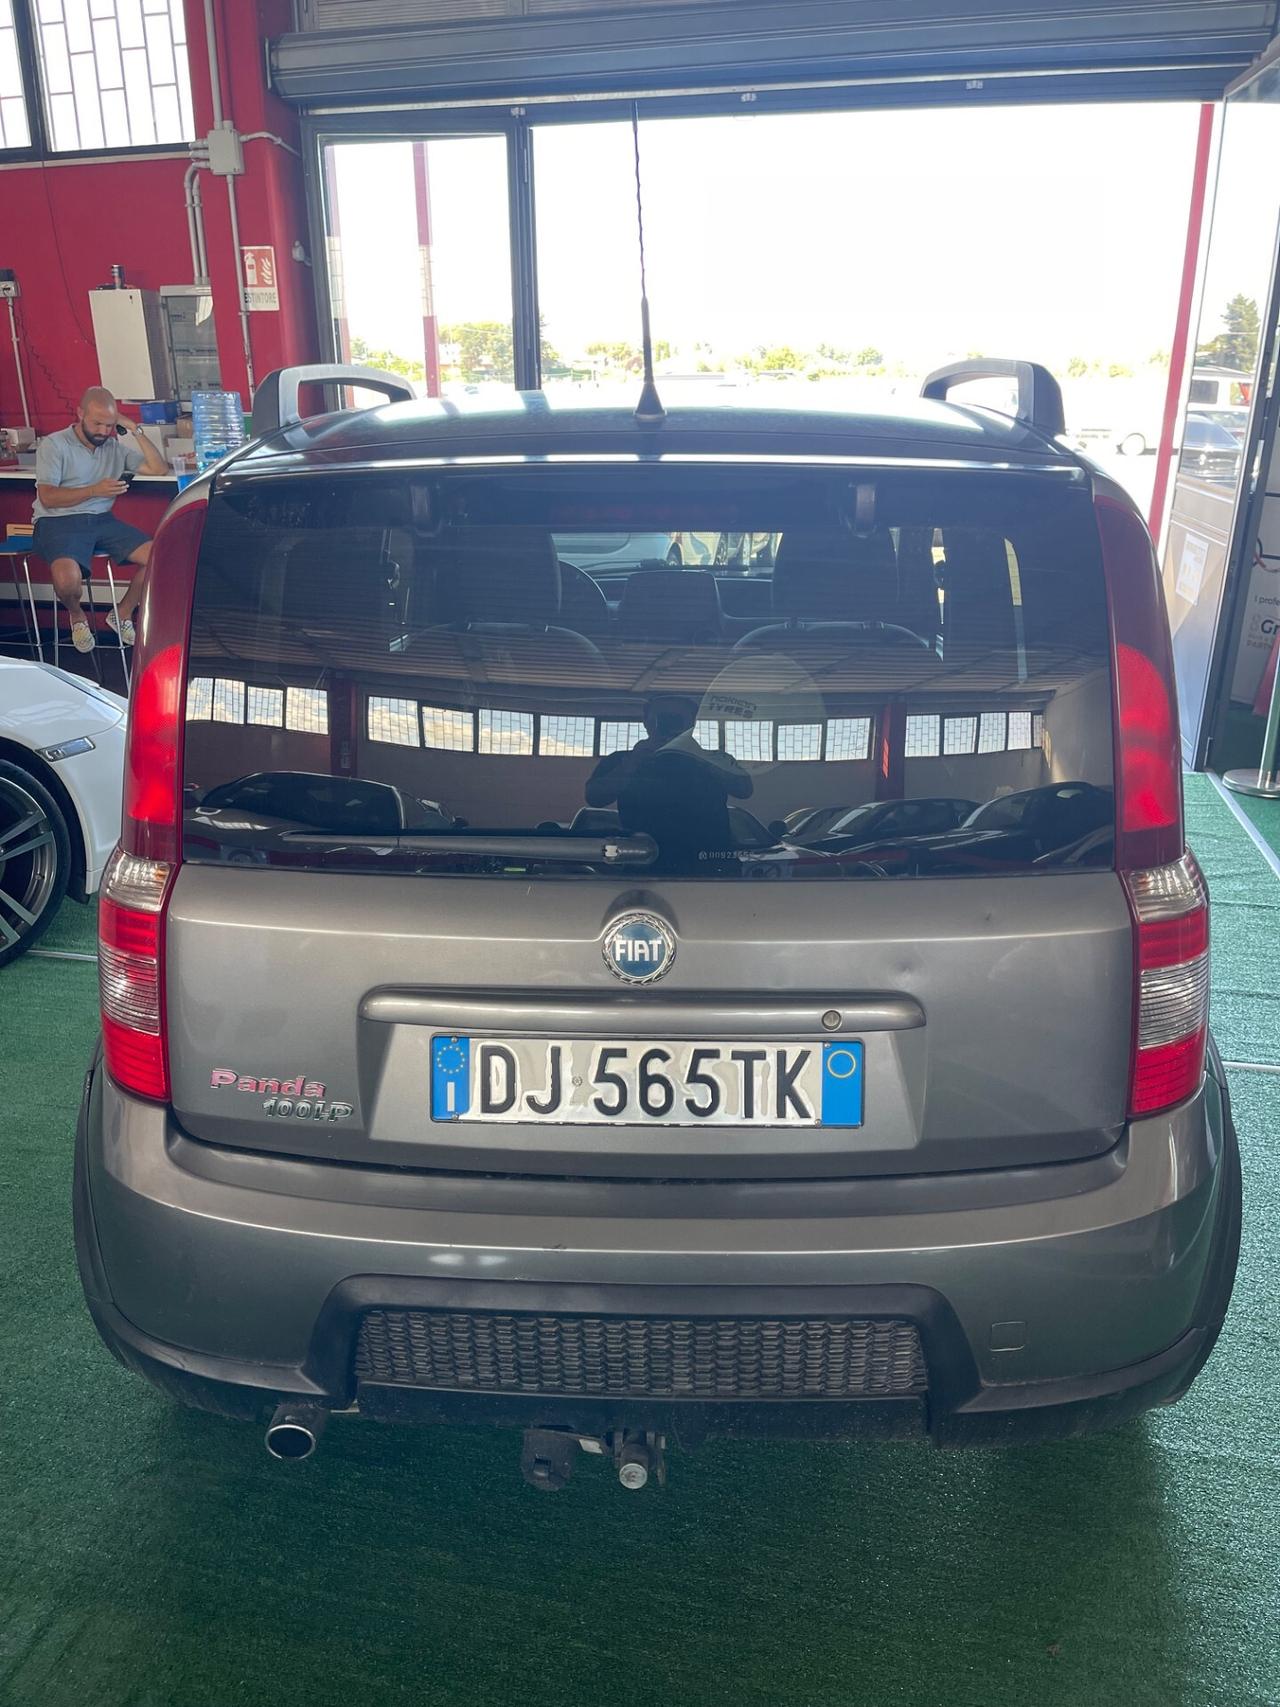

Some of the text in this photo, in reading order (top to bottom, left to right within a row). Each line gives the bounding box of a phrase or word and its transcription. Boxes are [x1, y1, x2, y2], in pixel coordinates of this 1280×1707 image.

[244, 292, 277, 304] ESTINTORE
[615, 938, 662, 962] FIAT
[210, 1068, 327, 1098] Panda
